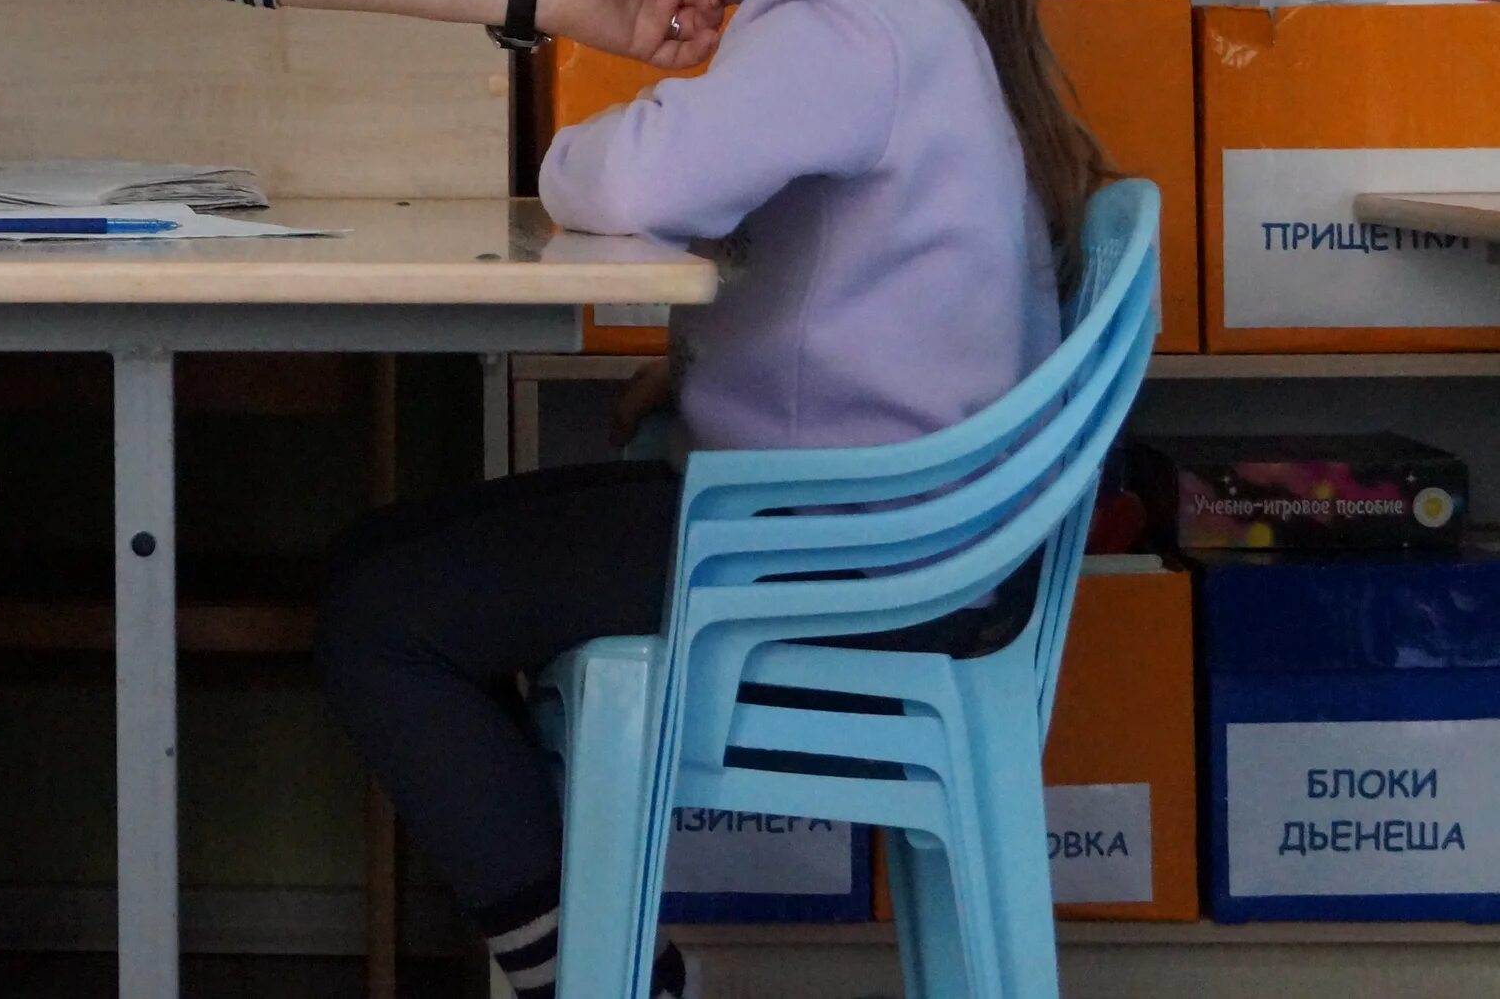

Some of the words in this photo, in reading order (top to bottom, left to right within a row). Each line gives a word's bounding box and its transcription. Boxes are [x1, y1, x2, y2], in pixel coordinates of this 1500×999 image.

[1336, 500, 1403, 519] пособие
[1307, 768, 1437, 799] БЛОКИ
[1279, 820, 1465, 856] ДЬЕНЕША
